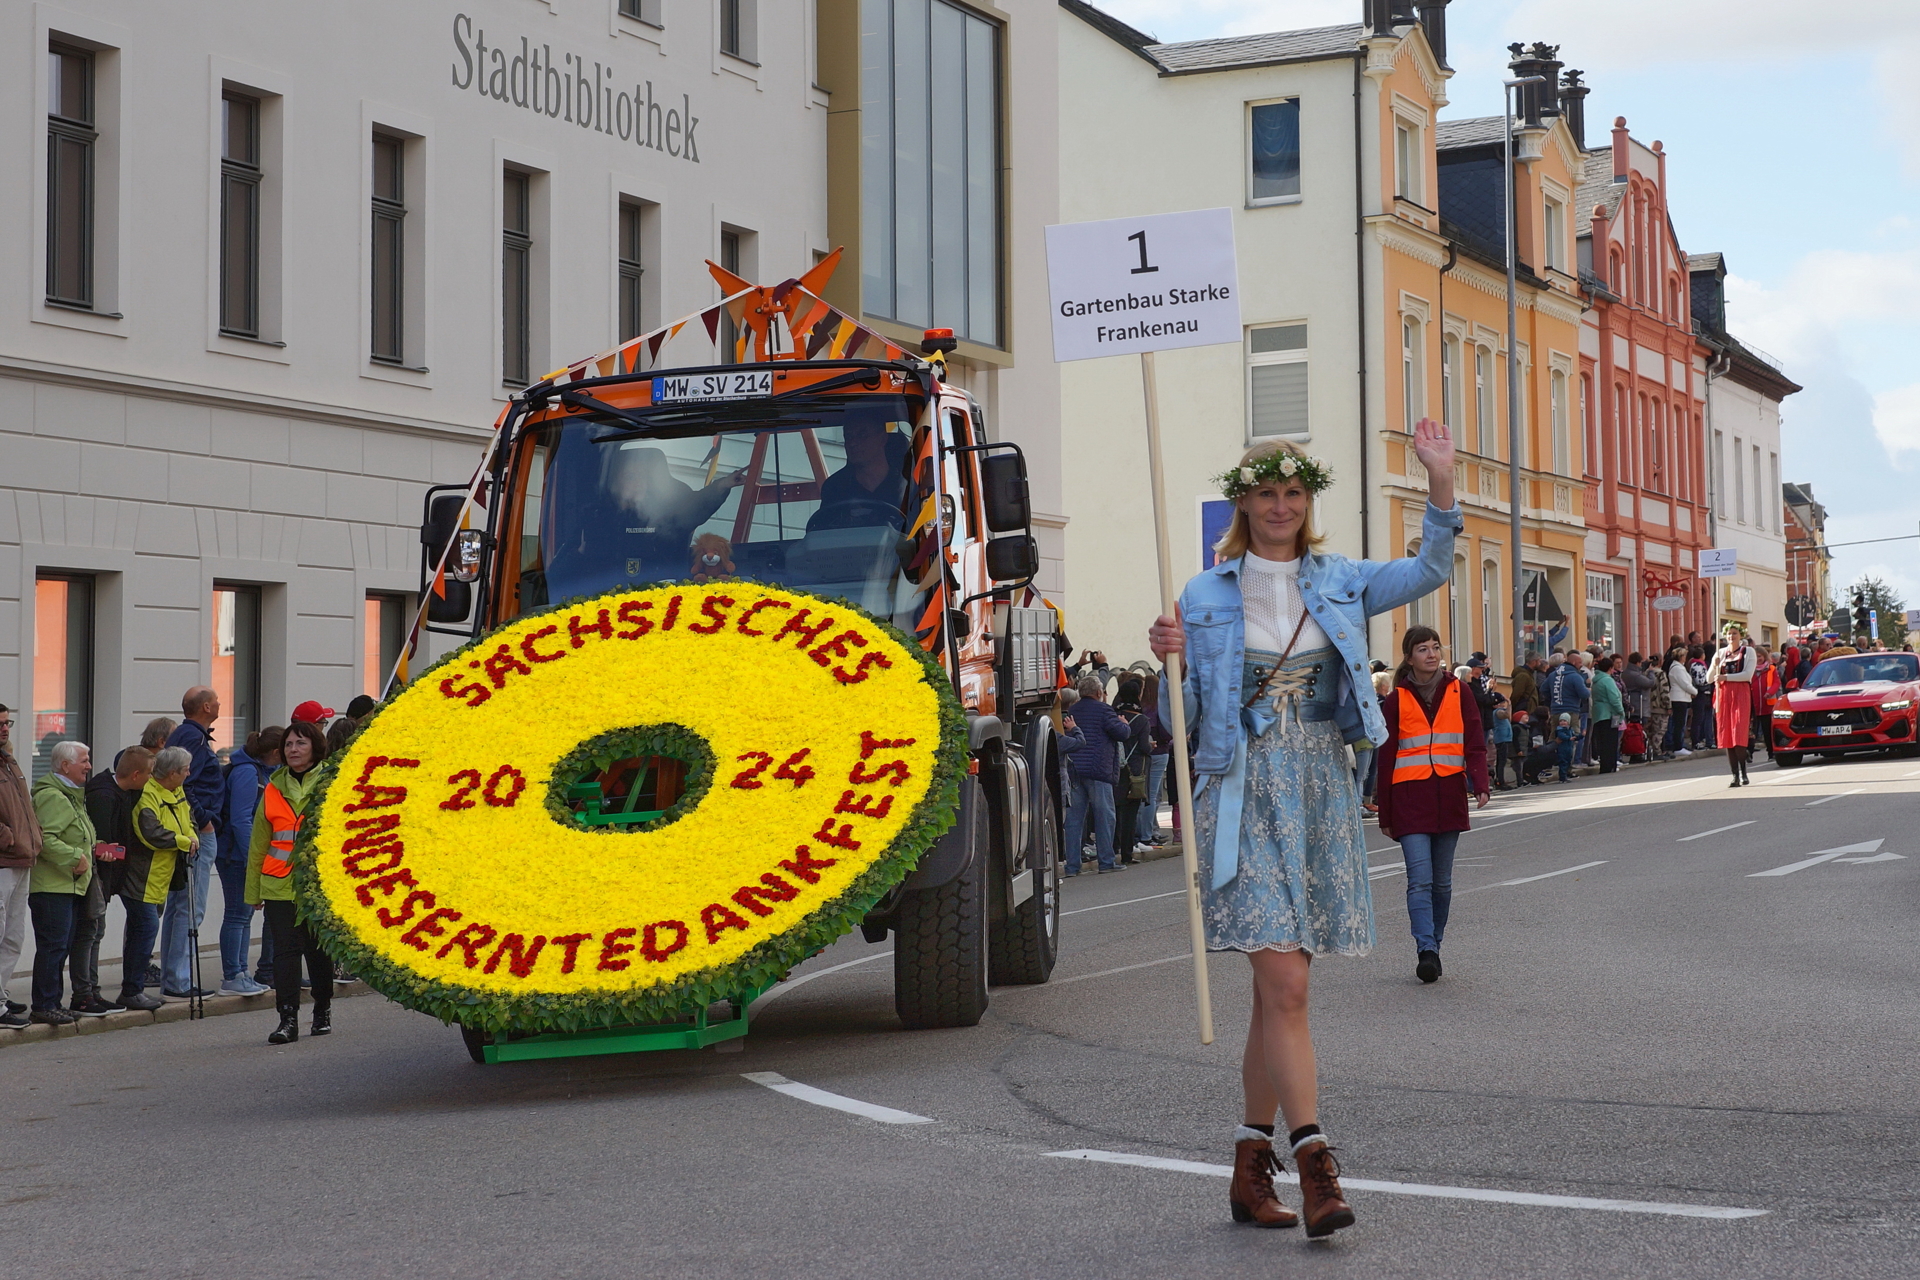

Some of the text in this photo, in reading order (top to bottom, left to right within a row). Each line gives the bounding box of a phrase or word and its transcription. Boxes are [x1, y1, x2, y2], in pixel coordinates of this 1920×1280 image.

[452, 13, 700, 163] Stadtbibliothek
[1128, 230, 1159, 275] 1
[1060, 284, 1230, 317] Gartenbau Starke
[1097, 319, 1199, 343] Frankenau
[663, 373, 771, 398] MW SV 214
[1715, 551, 1721, 561] 2
[439, 596, 893, 707] SÄCHSISCHES
[439, 747, 816, 812] 20 24
[341, 730, 917, 979] LANDESERNTEDANKFEST
